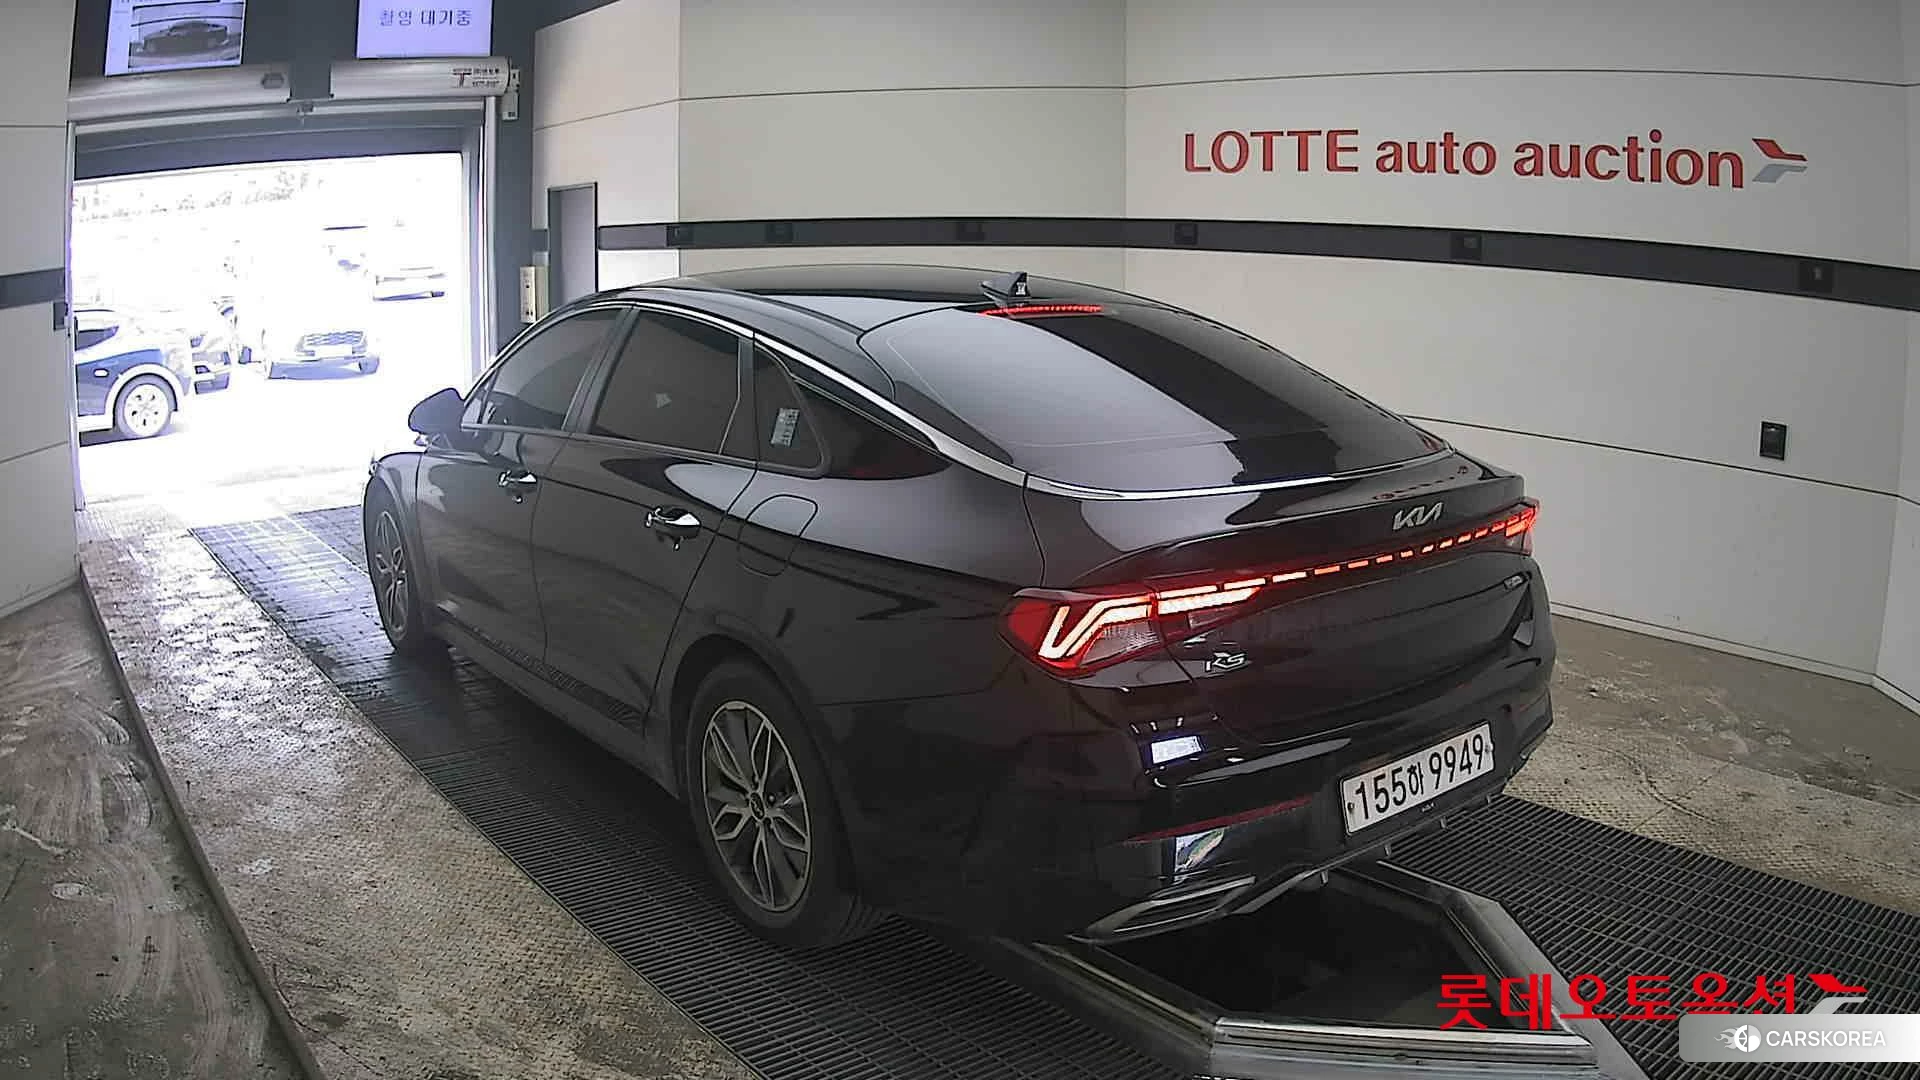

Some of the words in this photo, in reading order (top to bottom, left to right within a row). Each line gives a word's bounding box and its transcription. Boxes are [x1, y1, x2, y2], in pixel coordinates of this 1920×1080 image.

[420, 9, 472, 26] 대기중
[1185, 129, 1359, 173] LOTTE
[1375, 131, 1497, 176] auto
[1513, 129, 1745, 188] auction
[1355, 762, 1424, 820] 155하
[1429, 734, 1484, 789] 9949
